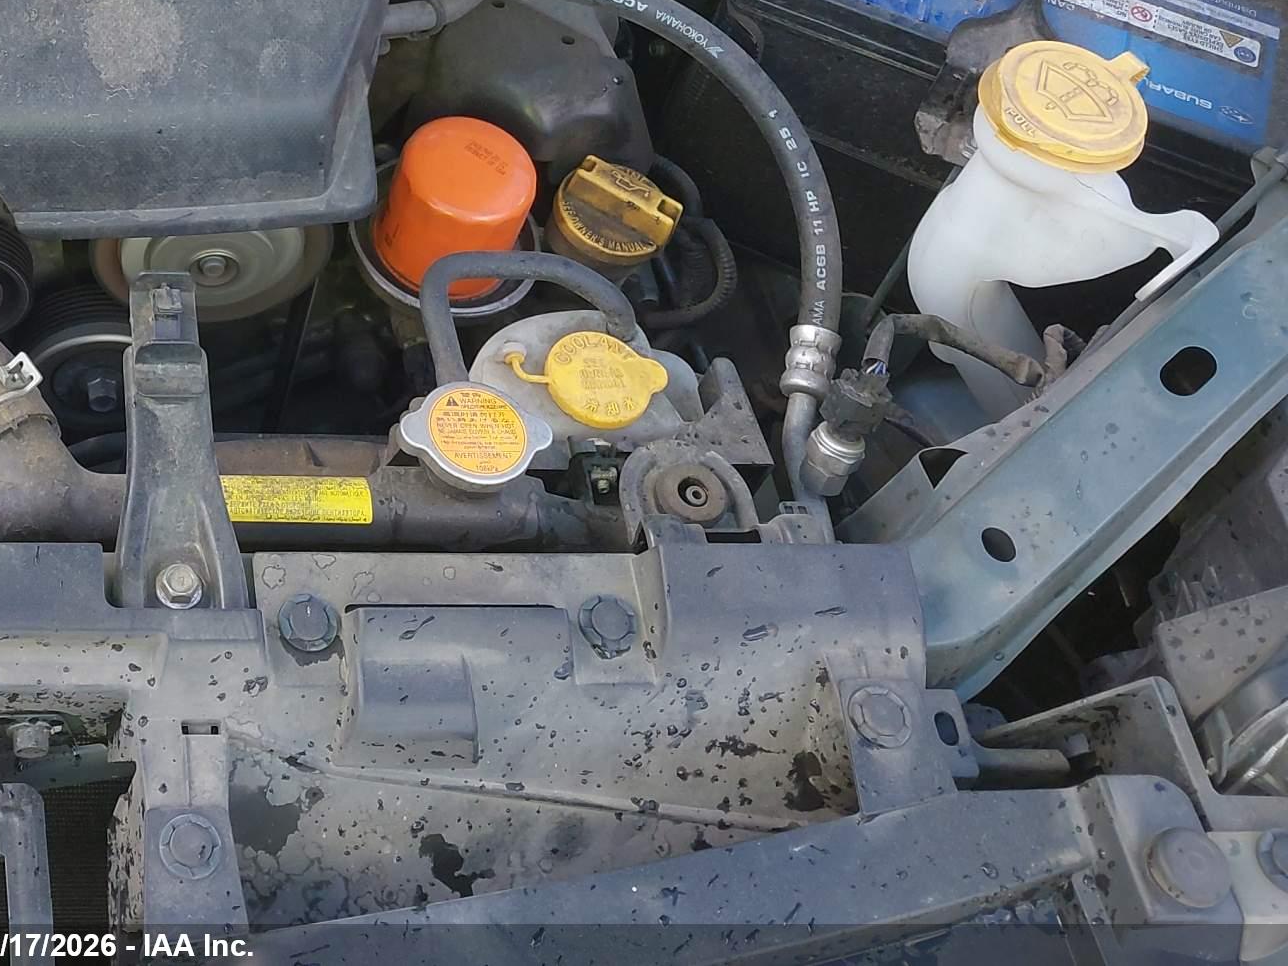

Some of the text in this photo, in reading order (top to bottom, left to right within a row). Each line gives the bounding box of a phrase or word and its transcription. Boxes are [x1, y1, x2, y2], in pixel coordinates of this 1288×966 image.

[655, 9, 710, 48] YOKOHAMA
[1006, 106, 1037, 138] PULL
[778, 127, 798, 151] 25
[796, 161, 810, 179] IC
[805, 190, 821, 213] HP
[813, 219, 824, 236] 11
[607, 239, 647, 252] MANUAL
[816, 244, 827, 291] AC6B
[553, 335, 635, 363] COOLANT
